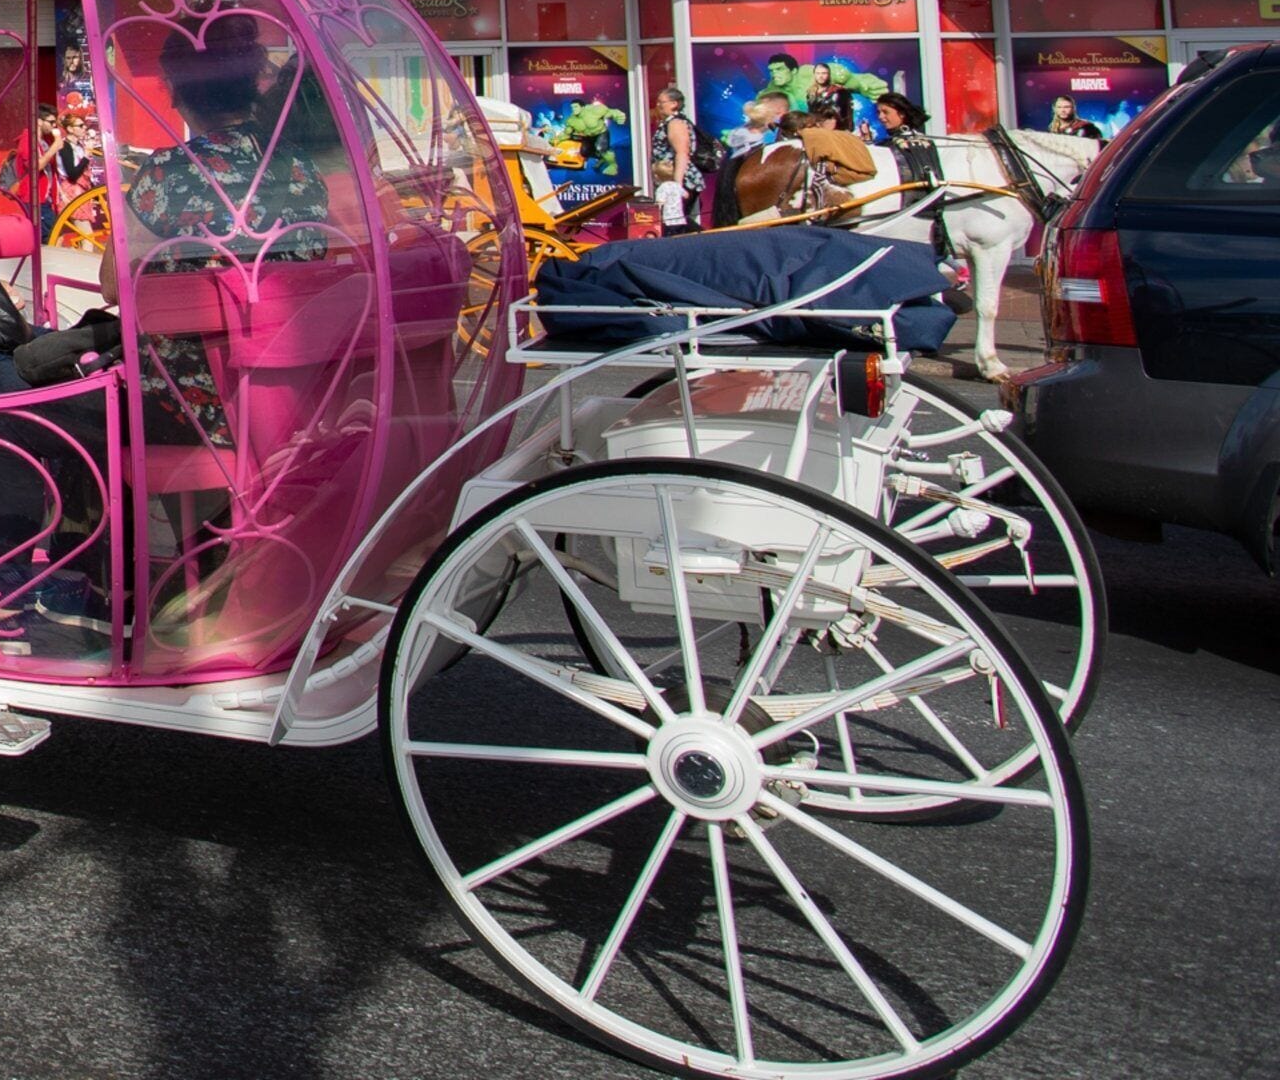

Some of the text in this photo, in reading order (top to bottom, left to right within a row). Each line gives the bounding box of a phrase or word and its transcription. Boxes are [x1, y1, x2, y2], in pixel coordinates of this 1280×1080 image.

[528, 58, 608, 71] Madame Tussauds
[1038, 51, 1141, 65] Madame Tussauds
[553, 82, 584, 95] MARVEL
[1071, 78, 1110, 91] MARVEL
[570, 184, 620, 193] AS STRO
[559, 192, 575, 201] HE
